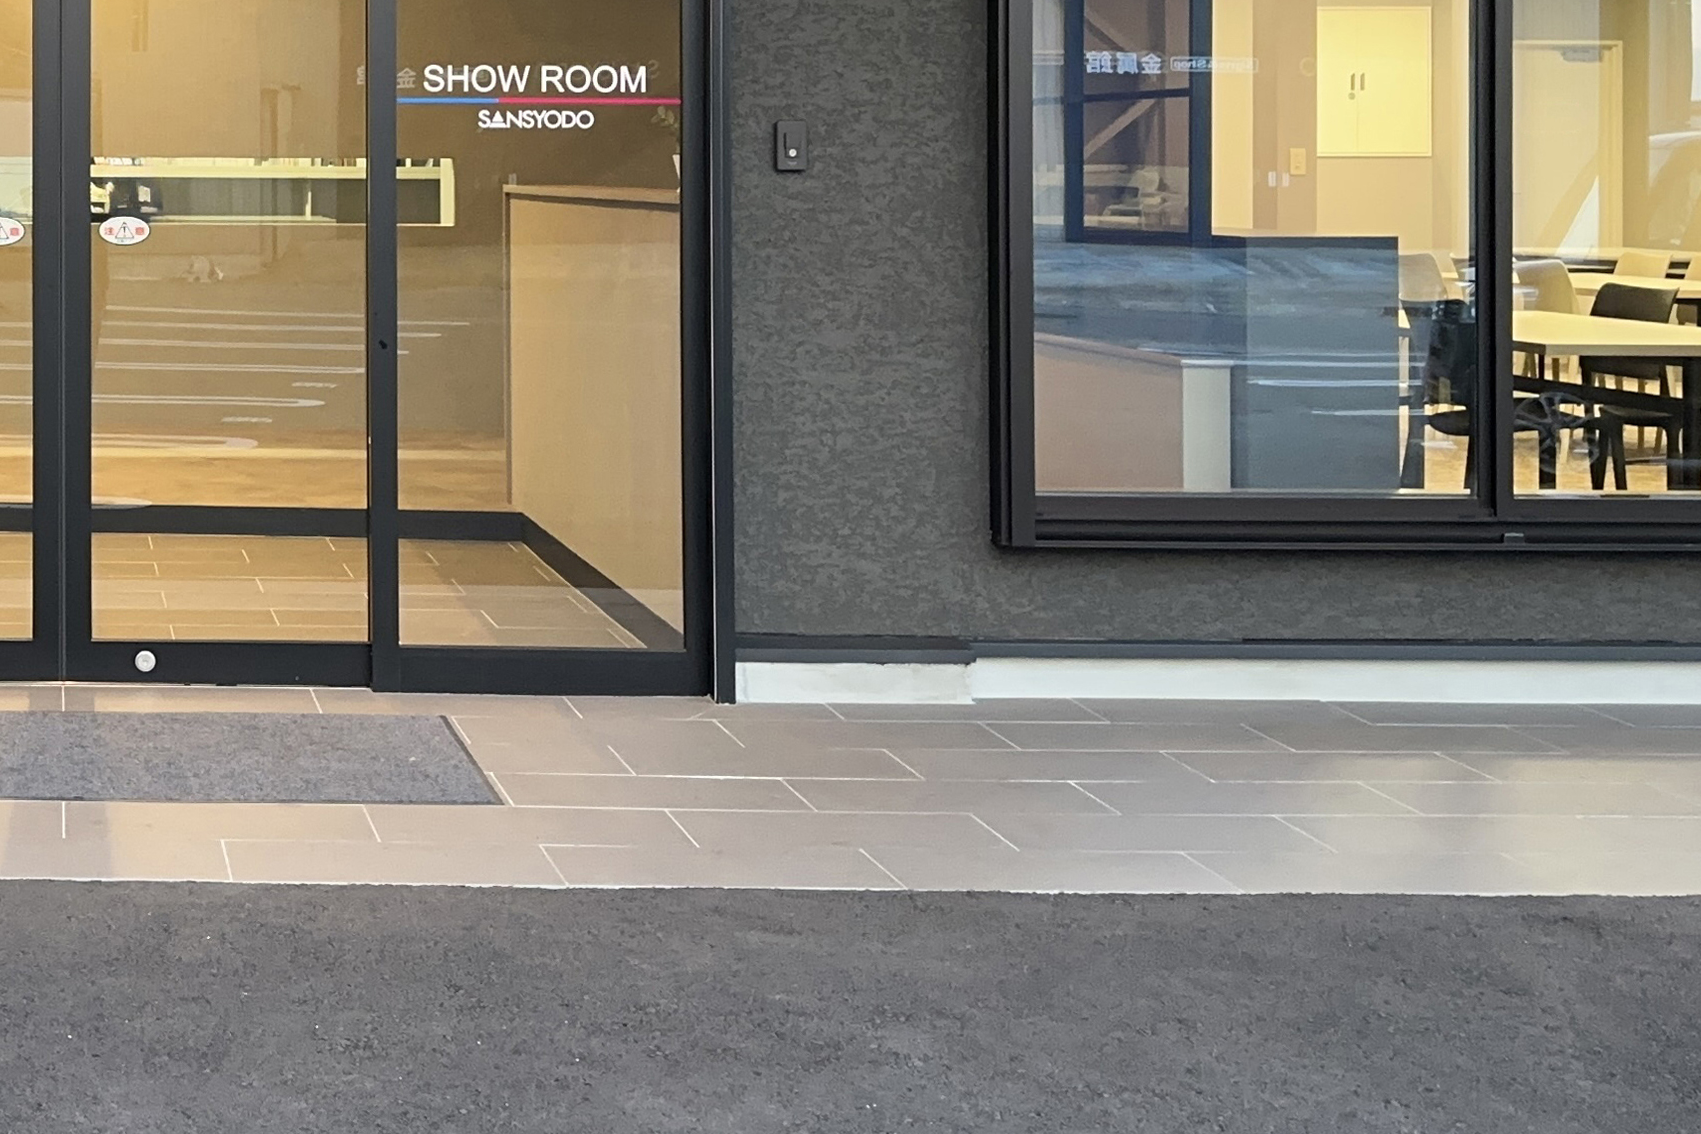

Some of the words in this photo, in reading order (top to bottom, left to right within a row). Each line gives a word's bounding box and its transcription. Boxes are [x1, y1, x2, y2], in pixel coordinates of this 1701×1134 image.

[423, 64, 531, 93] SHOW
[540, 65, 647, 93] ROOM
[477, 109, 595, 129] SANSYODO
